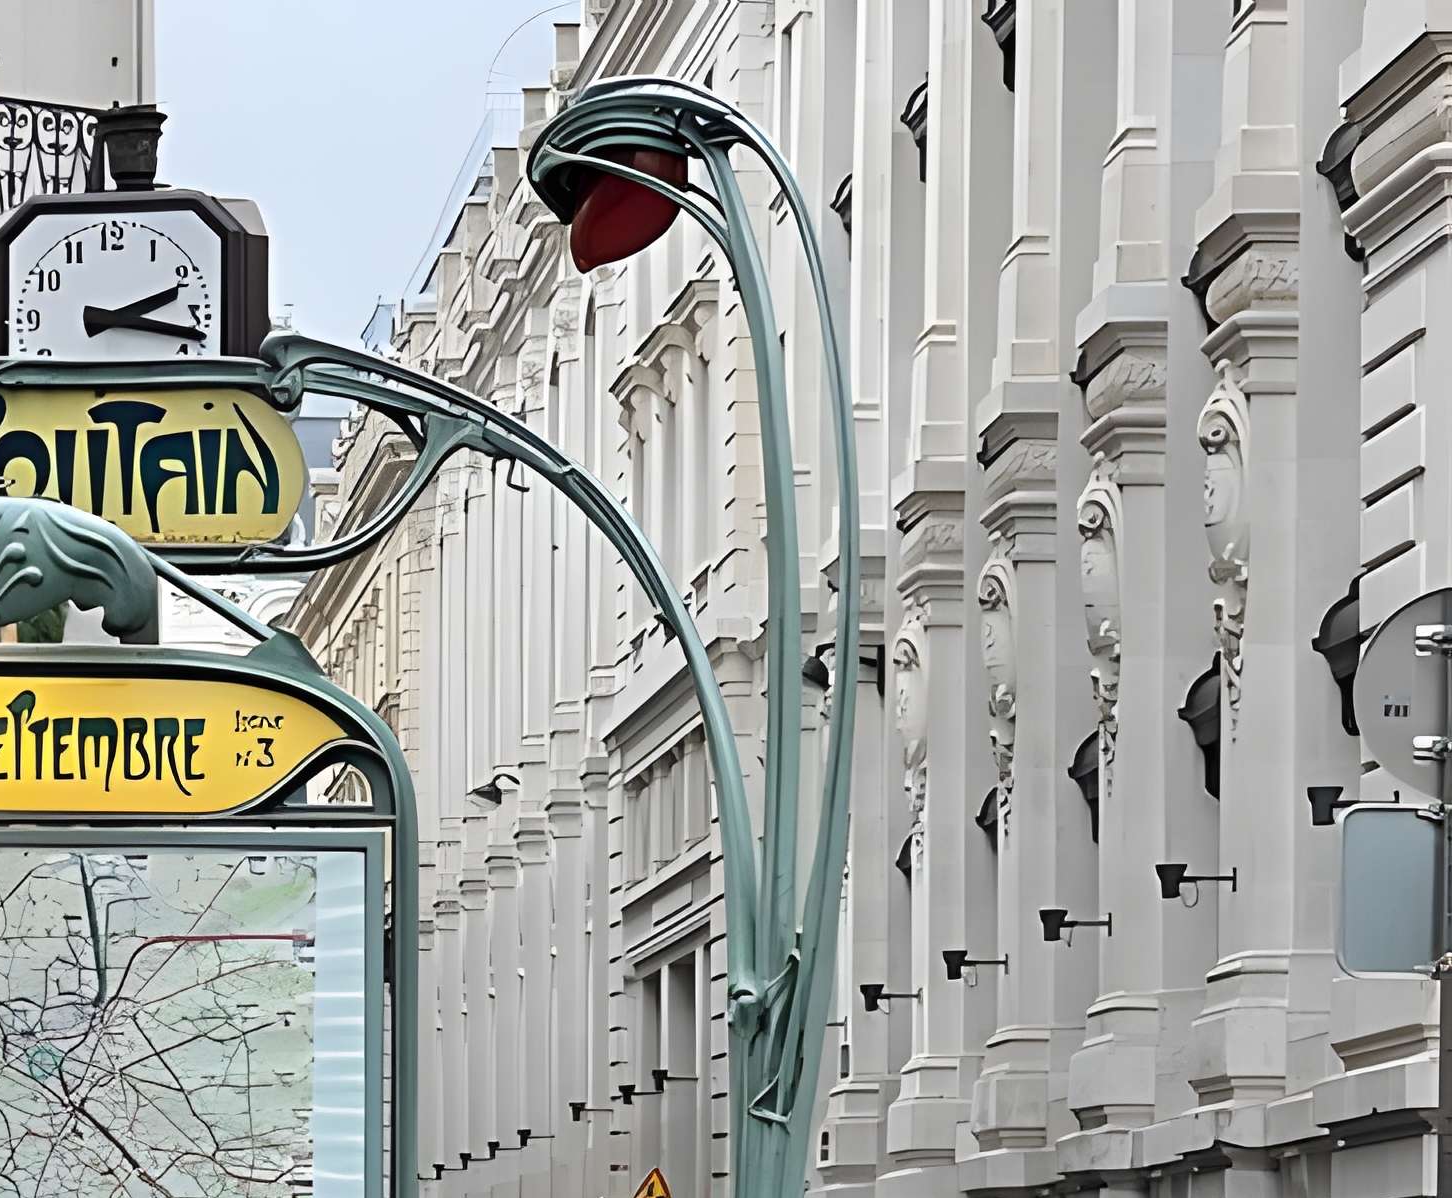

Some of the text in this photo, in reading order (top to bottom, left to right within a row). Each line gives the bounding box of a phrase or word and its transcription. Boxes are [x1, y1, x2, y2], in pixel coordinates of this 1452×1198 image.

[64, 240, 84, 264] 11
[150, 239, 157, 262] 1
[37, 269, 61, 292] 10
[26, 309, 41, 331] 9
